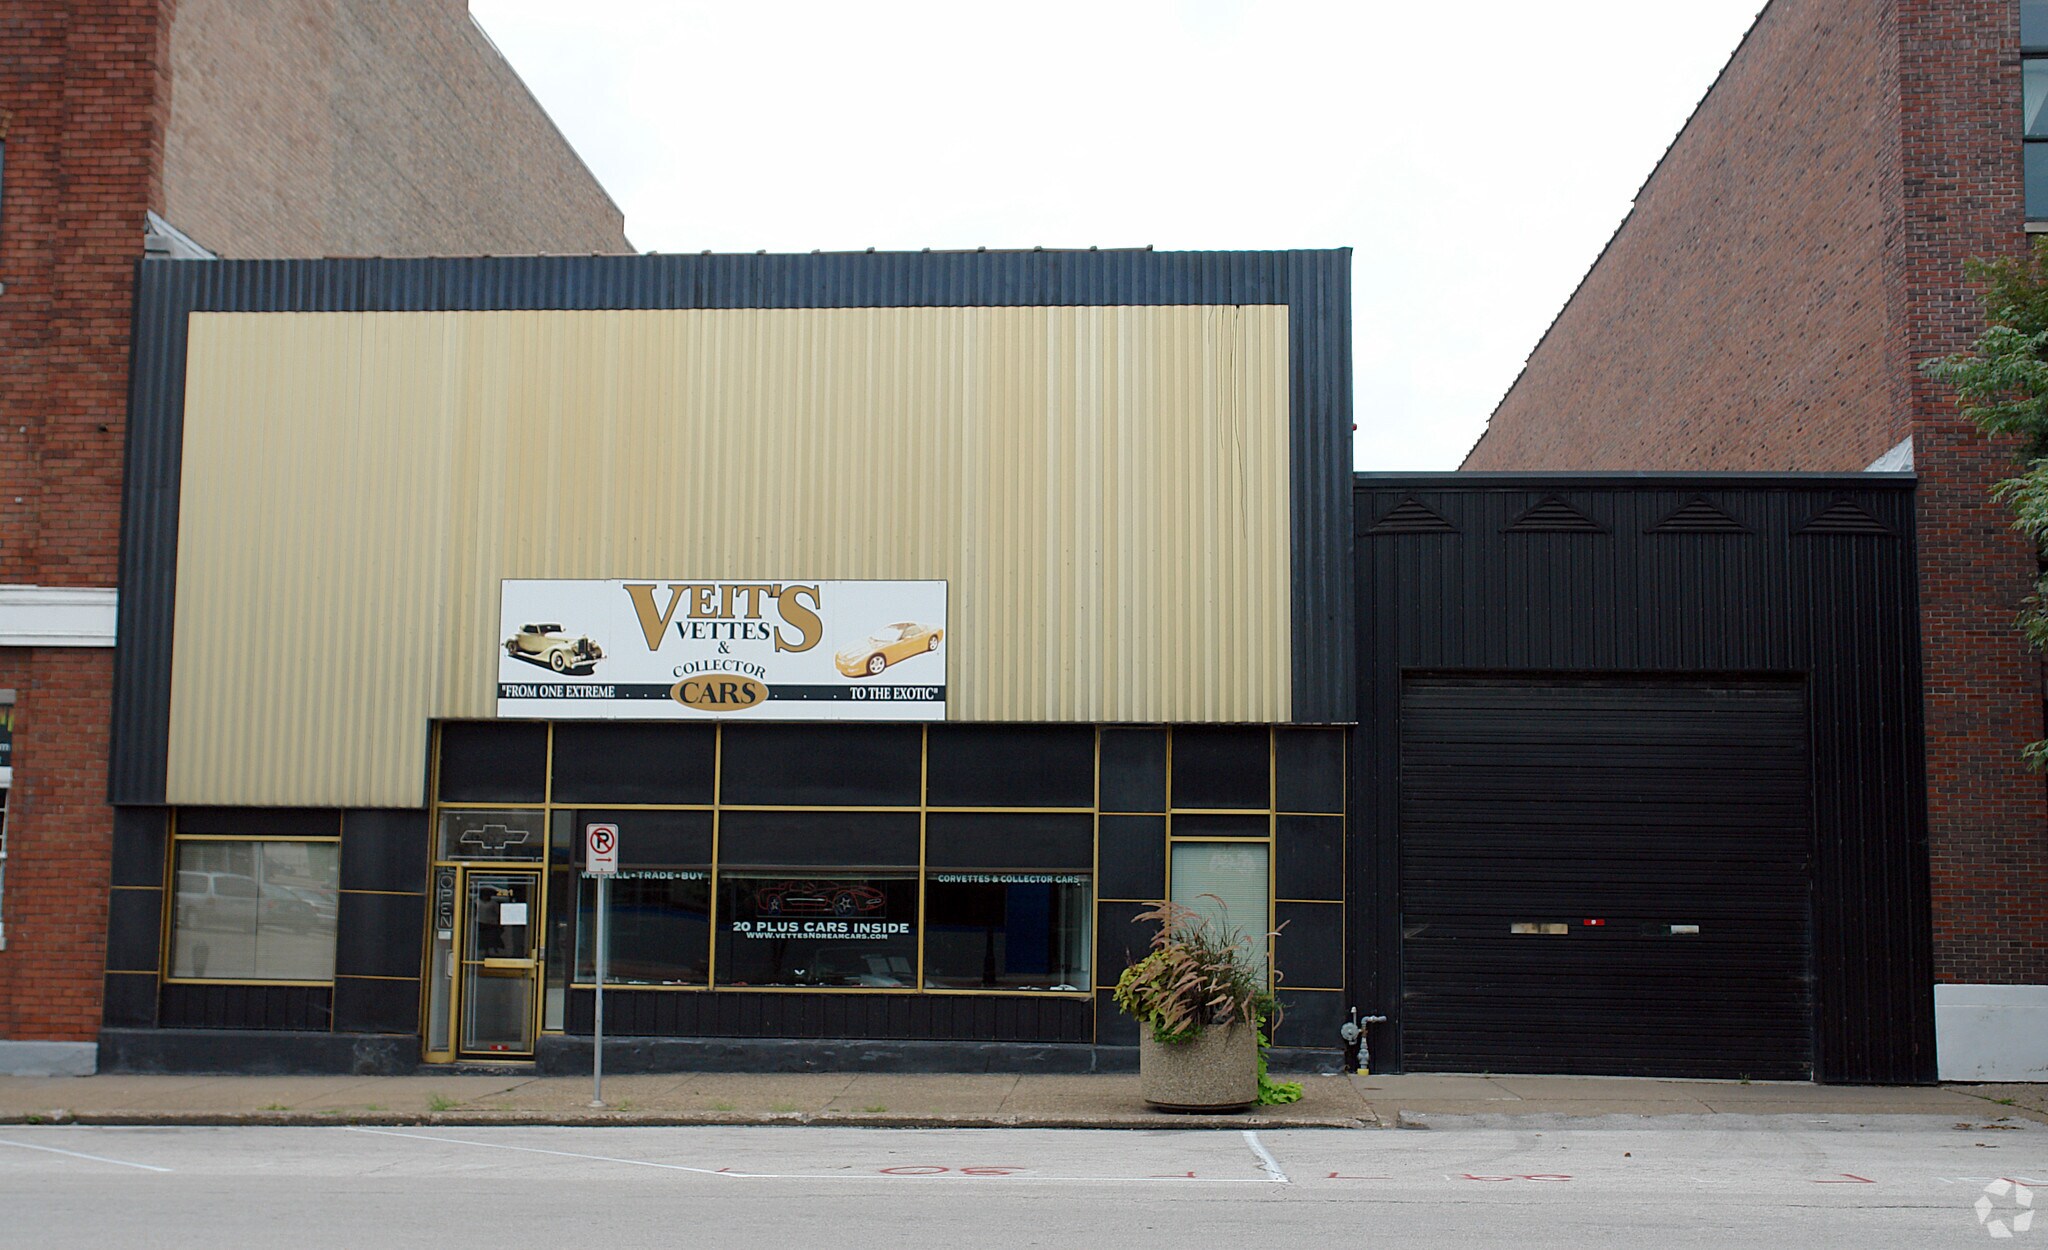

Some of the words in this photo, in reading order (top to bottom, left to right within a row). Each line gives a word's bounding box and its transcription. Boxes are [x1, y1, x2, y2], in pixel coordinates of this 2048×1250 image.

[623, 584, 823, 653] VEIT'S
[675, 621, 770, 640] VETTES
[717, 641, 730, 654] &
[673, 659, 766, 679] COLLECTOR
[539, 685, 564, 698] ONE
[566, 685, 615, 698] EXTREME
[679, 681, 756, 705] CARS
[850, 687, 866, 700] TO
[867, 687, 891, 700] THE
[637, 871, 673, 880] TRADE
[681, 871, 704, 880] BUY
[938, 874, 990, 883] CORVETTES
[992, 875, 998, 883] &
[1000, 875, 1053, 883] COLLECTOR
[1055, 875, 1079, 884] CARS
[440, 875, 453, 928] OPEN
[733, 921, 751, 932] 20
[756, 922, 799, 932] PLUS
[803, 922, 848, 933] CARS
[854, 923, 909, 934] INSIDE
